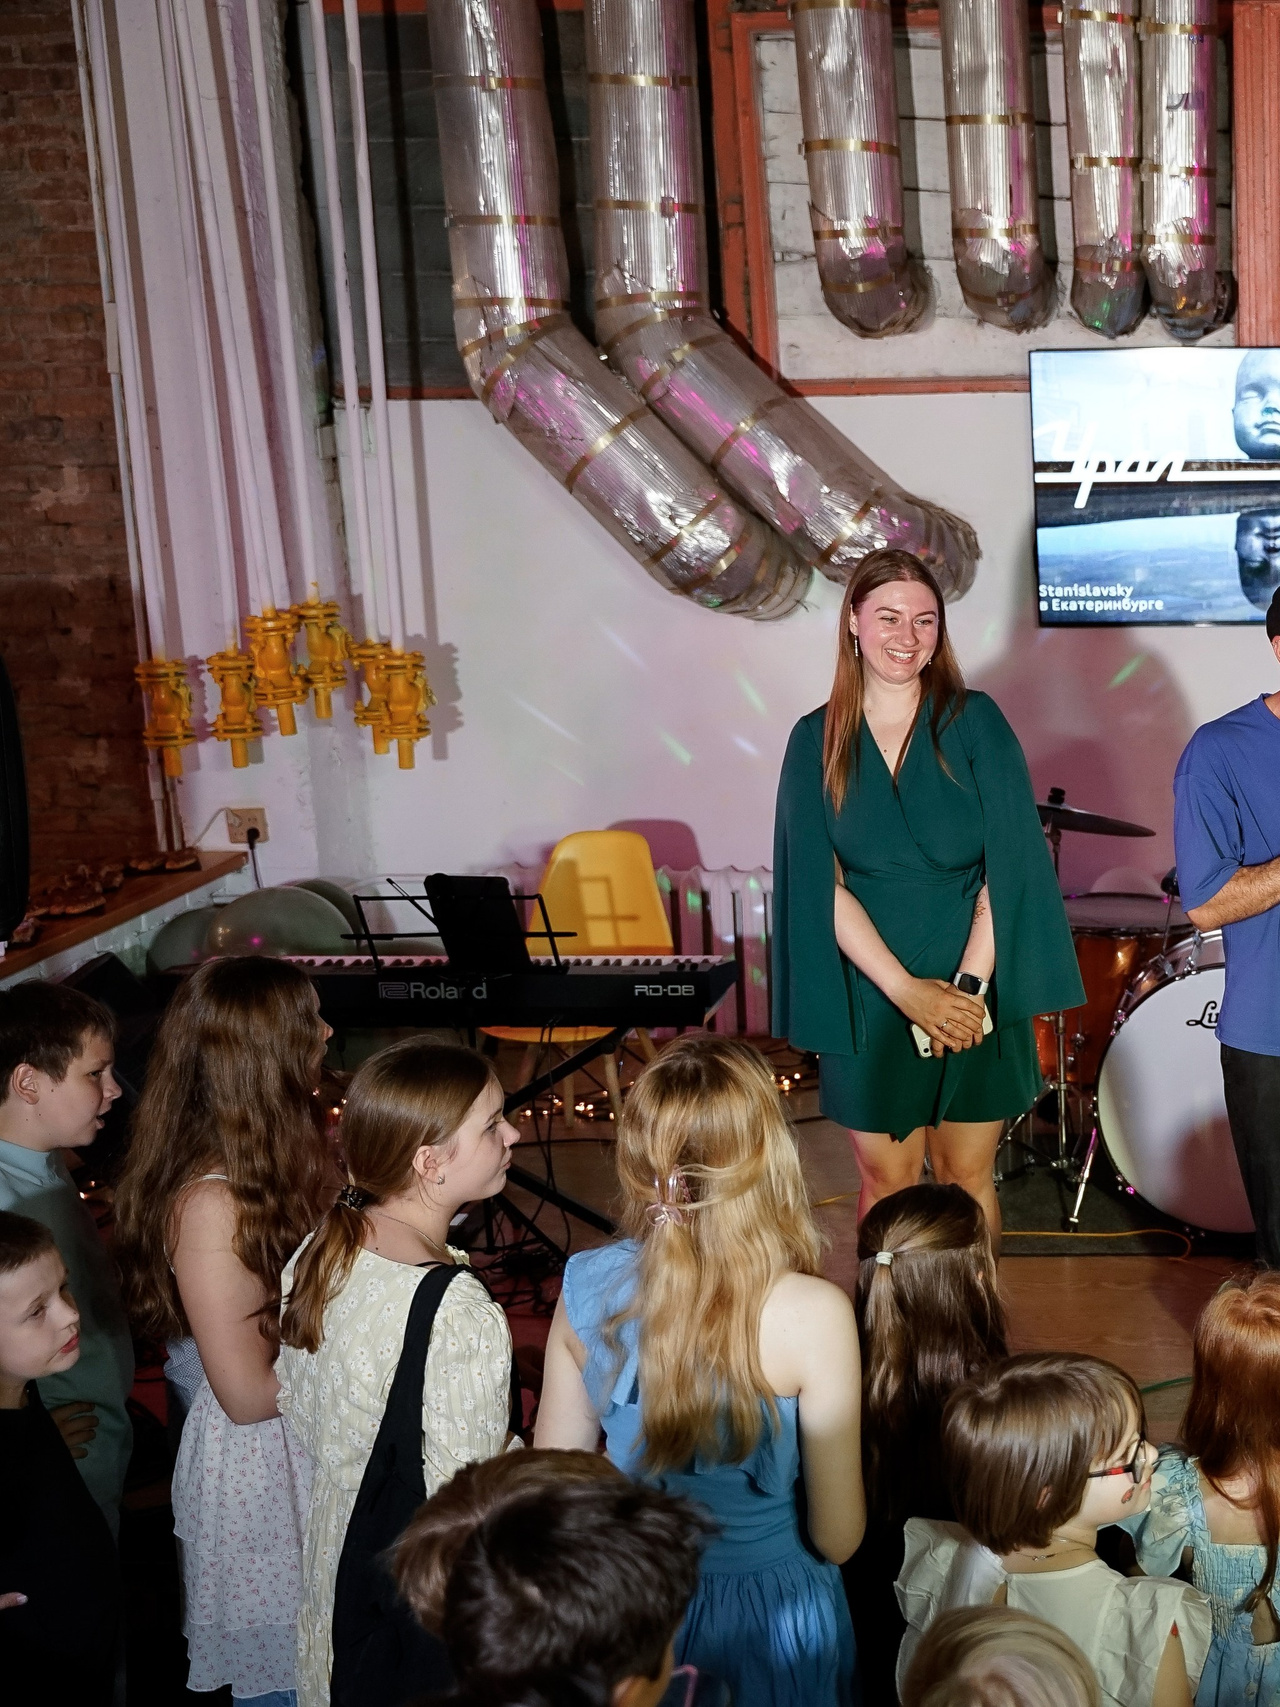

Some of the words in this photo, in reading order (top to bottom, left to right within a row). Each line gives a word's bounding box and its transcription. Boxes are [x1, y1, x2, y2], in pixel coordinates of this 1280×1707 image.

[1039, 583, 1134, 598] Stanislavsky
[1039, 601, 1049, 611] в
[1051, 597, 1164, 613] Екатеринбурге
[634, 985, 695, 996] RD-08
